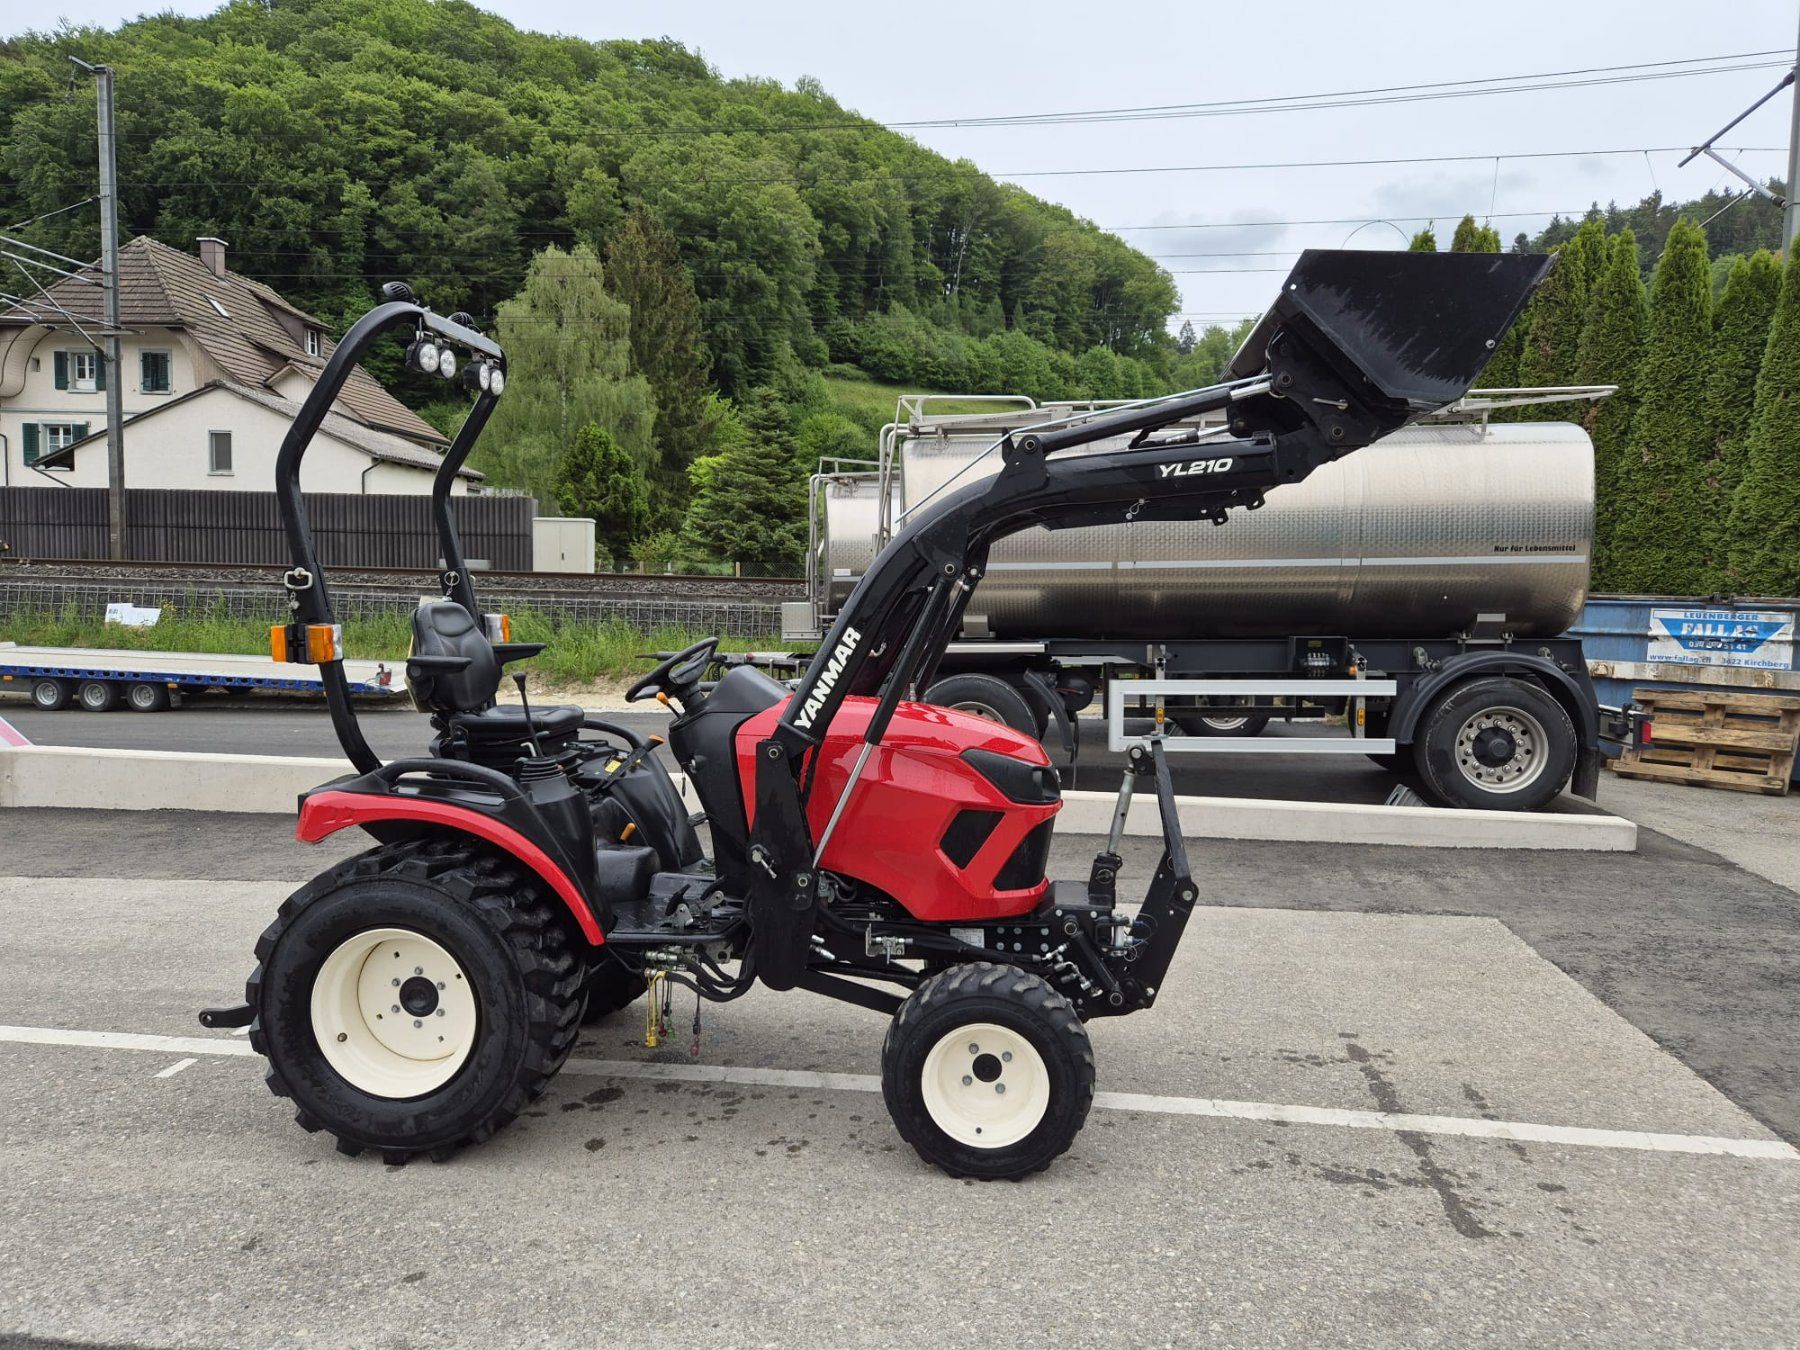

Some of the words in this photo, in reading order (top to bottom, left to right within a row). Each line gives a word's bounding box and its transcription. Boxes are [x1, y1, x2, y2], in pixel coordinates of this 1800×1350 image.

[1159, 458, 1233, 478] YL210
[1525, 544, 1576, 552] Lebensmittel
[1683, 612, 1759, 621] LEUENBERGER
[1744, 659, 1789, 671] Kirchberg
[793, 626, 862, 729] YANMAR
